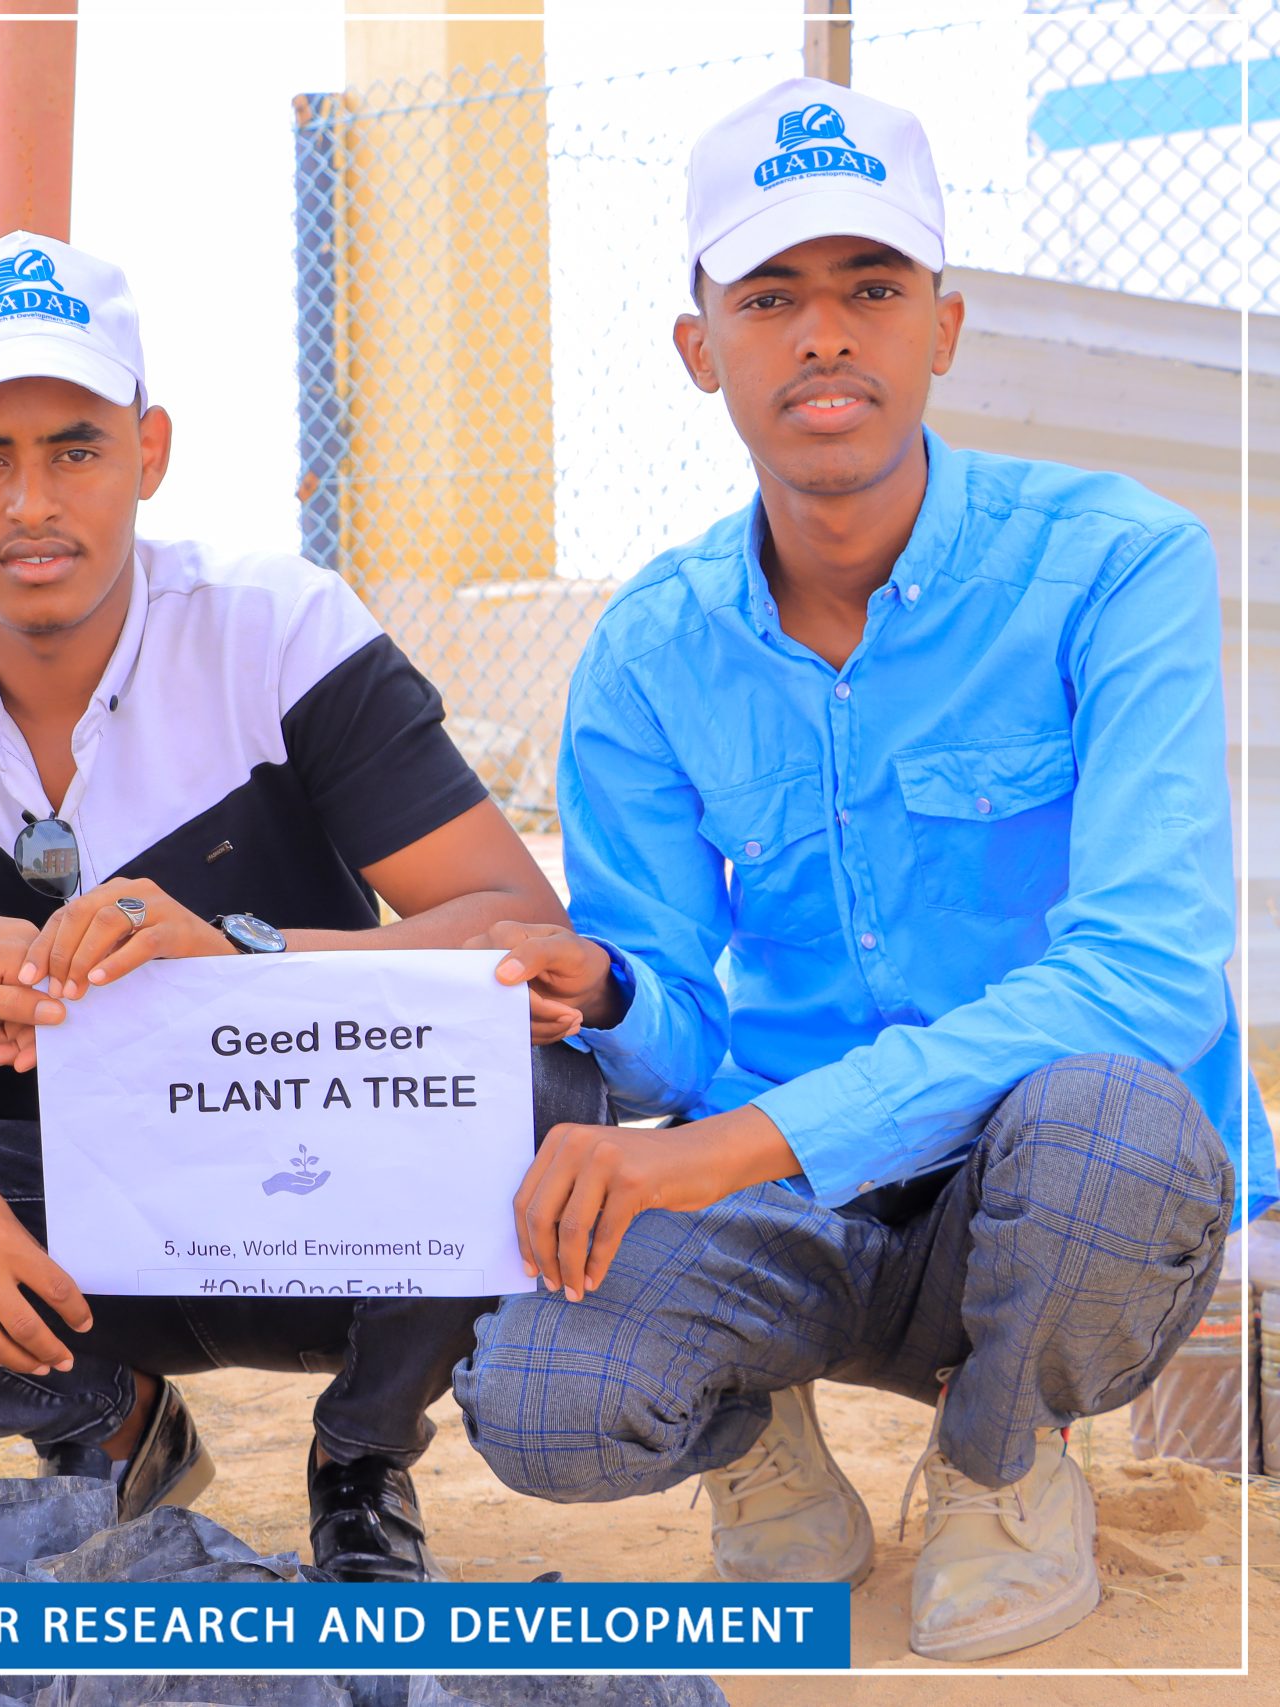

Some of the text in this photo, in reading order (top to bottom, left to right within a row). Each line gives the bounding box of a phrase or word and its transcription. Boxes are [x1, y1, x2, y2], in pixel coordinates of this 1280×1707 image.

[760, 150, 879, 182] HADAF
[17, 312, 64, 322] Development
[211, 1020, 433, 1056] Geed Beer
[169, 1075, 477, 1114] PLANT A TREE
[164, 1239, 465, 1260] 5, June, World Environment Day
